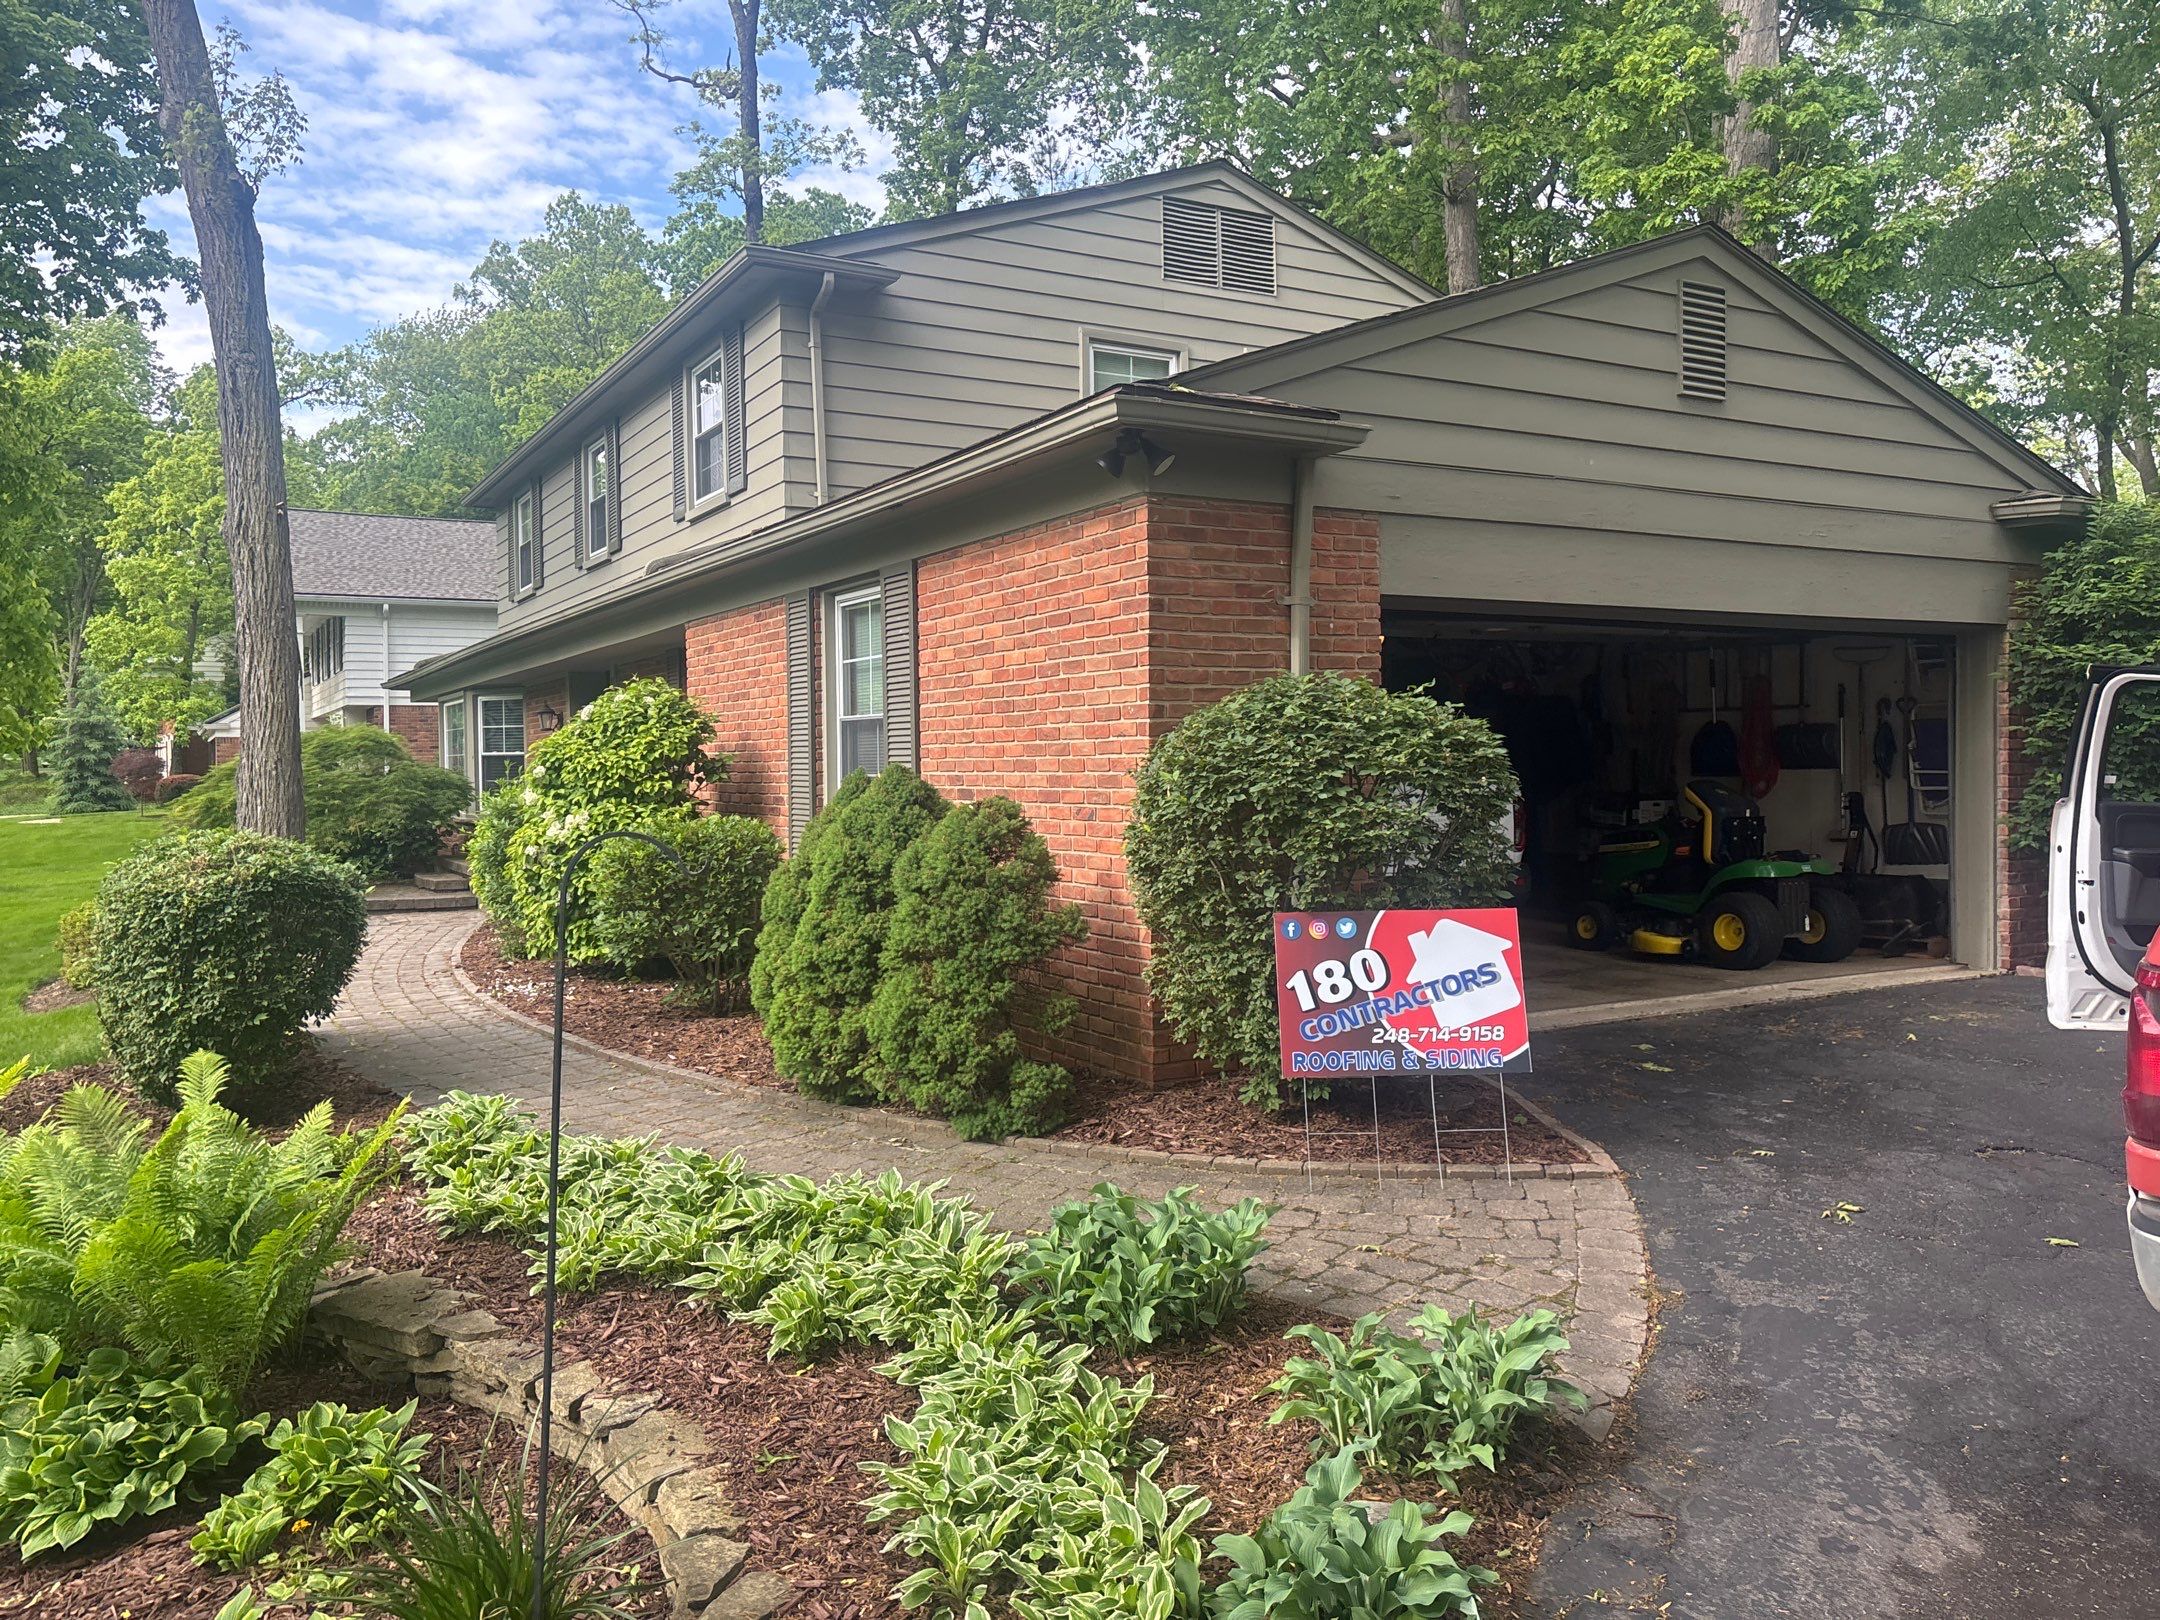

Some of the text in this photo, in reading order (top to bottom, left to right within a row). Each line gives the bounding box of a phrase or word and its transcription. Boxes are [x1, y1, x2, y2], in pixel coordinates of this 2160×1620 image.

[1285, 949, 1389, 1012] 180
[1300, 962, 1501, 1042] CONTRACTORS
[1371, 1025, 1504, 1044] 248-714-9158
[1292, 1048, 1504, 1071] ROOFING & SIDING
